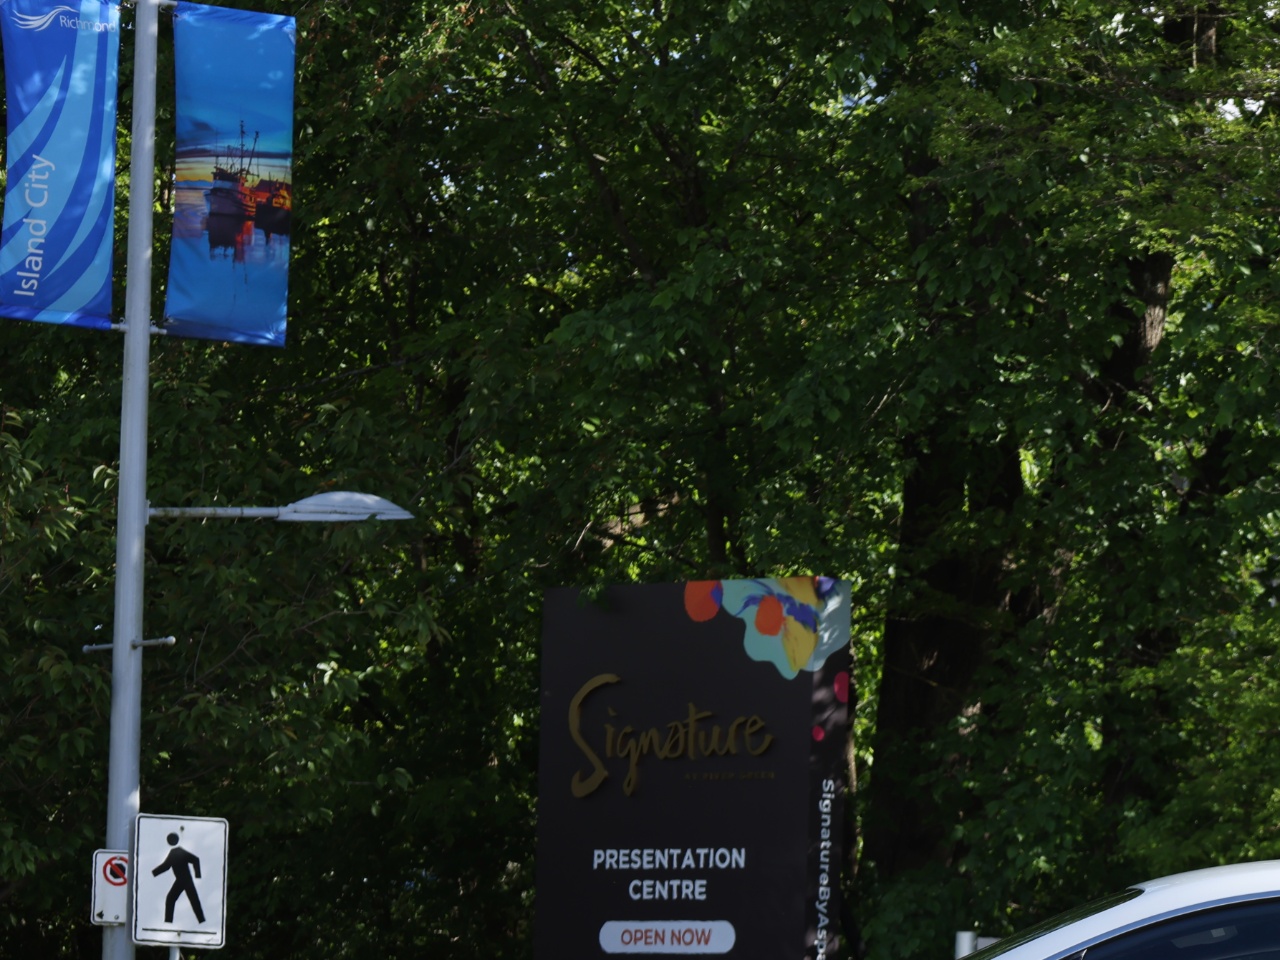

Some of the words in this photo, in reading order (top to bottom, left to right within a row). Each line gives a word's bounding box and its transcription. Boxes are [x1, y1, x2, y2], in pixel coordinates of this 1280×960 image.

[59, 15, 117, 33] Richmond
[24, 154, 56, 208] City
[14, 218, 47, 296] Island
[568, 672, 774, 798] Signature
[592, 847, 746, 870] PRESENTATION
[628, 879, 708, 901] CENTRE
[620, 928, 666, 946] OPEN
[670, 927, 713, 946] NOW
